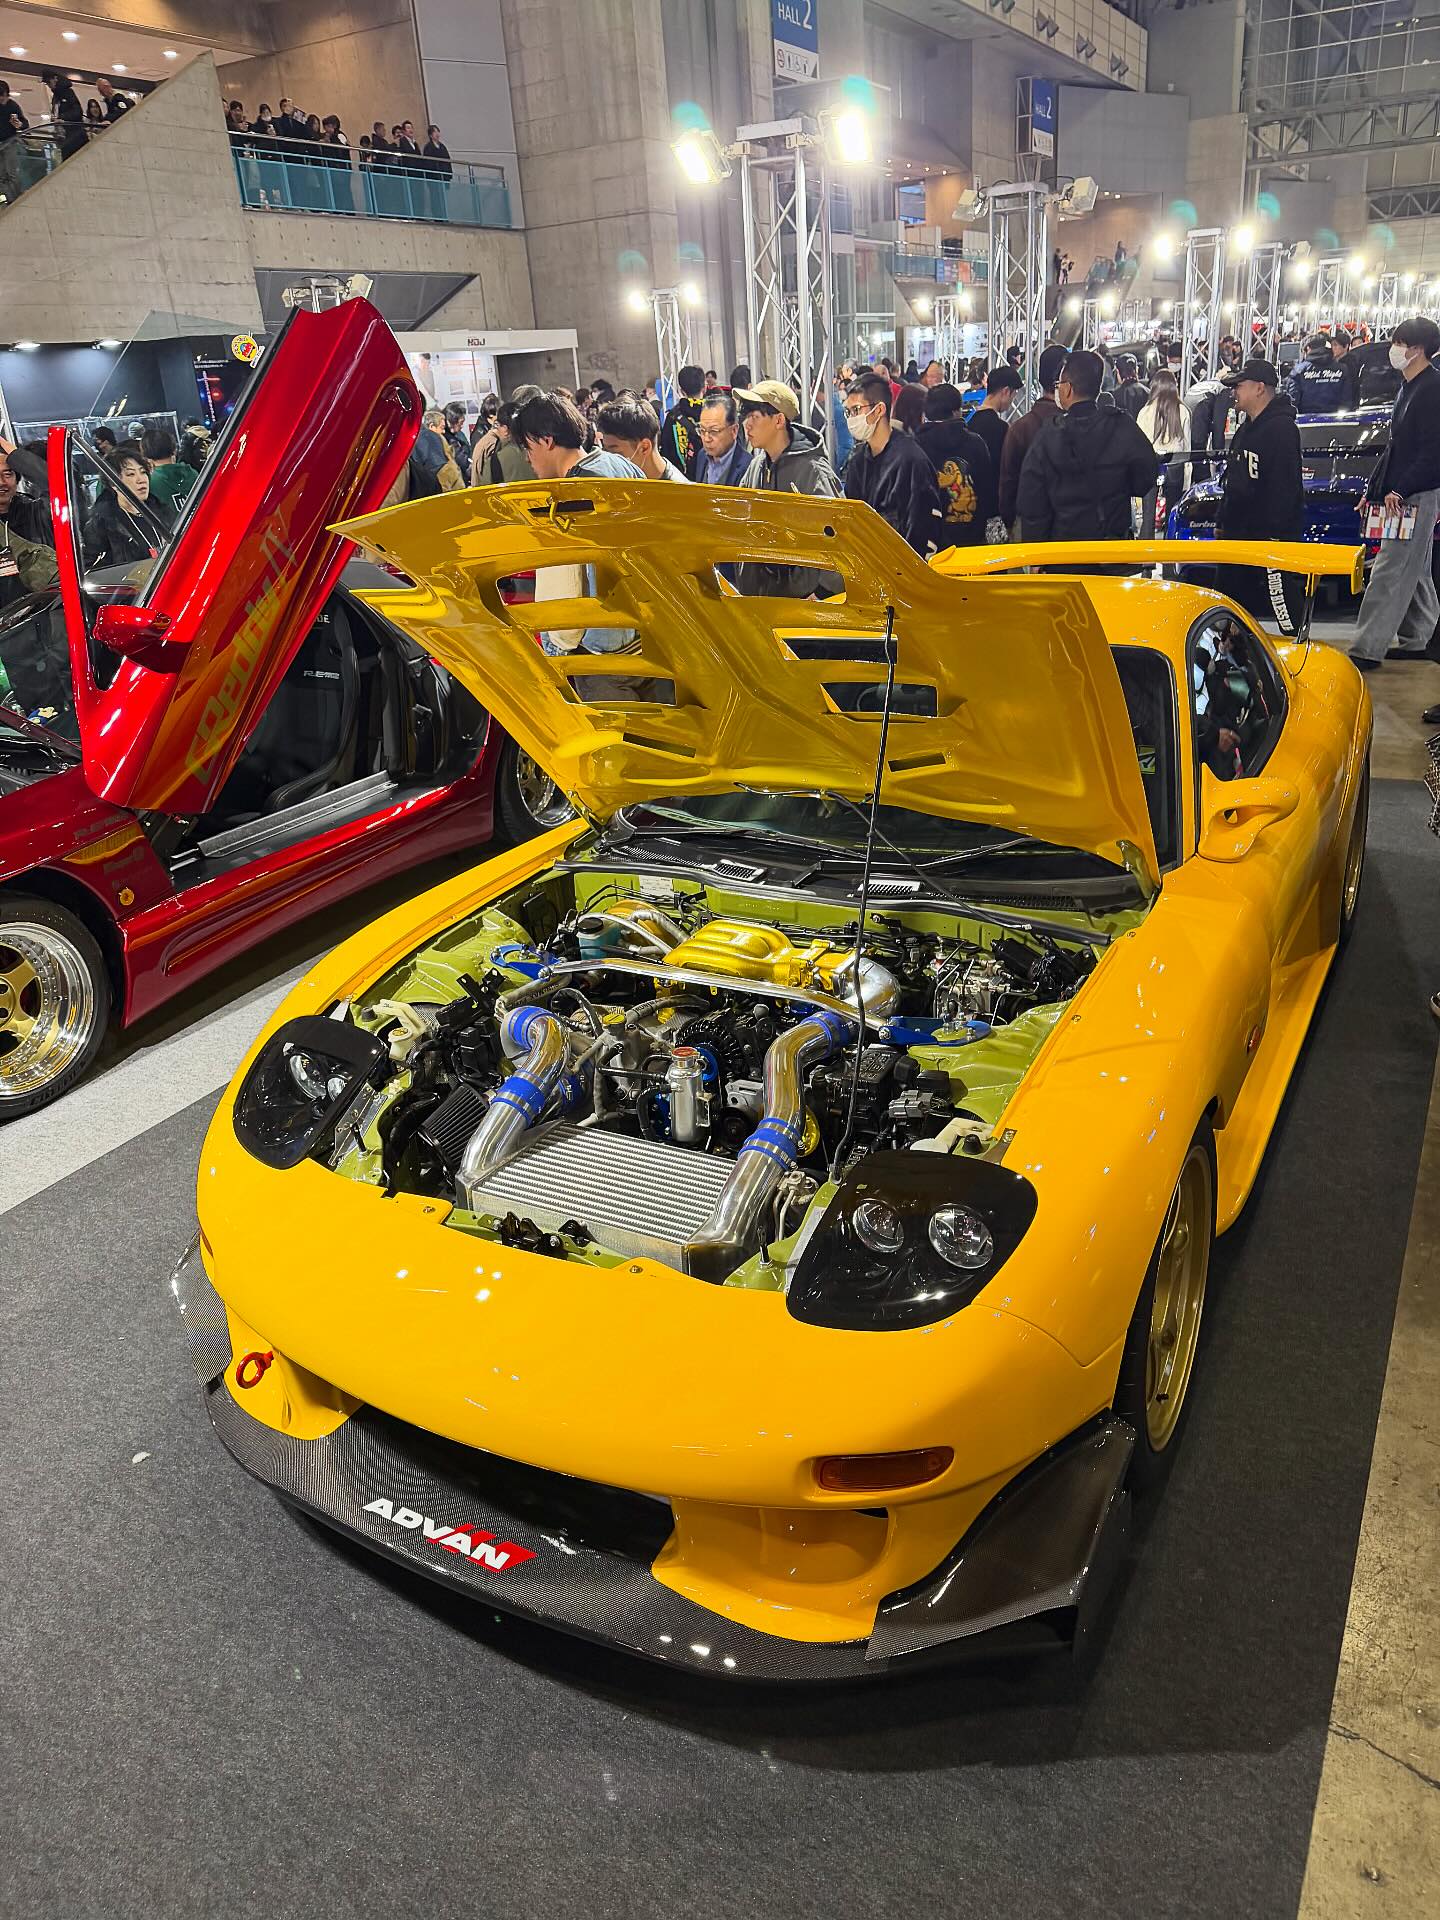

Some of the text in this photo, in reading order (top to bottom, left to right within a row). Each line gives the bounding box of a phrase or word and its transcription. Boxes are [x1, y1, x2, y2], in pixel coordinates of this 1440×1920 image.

[778, 0, 813, 30] HALL 2
[1046, 96, 1052, 119] 2
[363, 1498, 510, 1570] ADVAN
